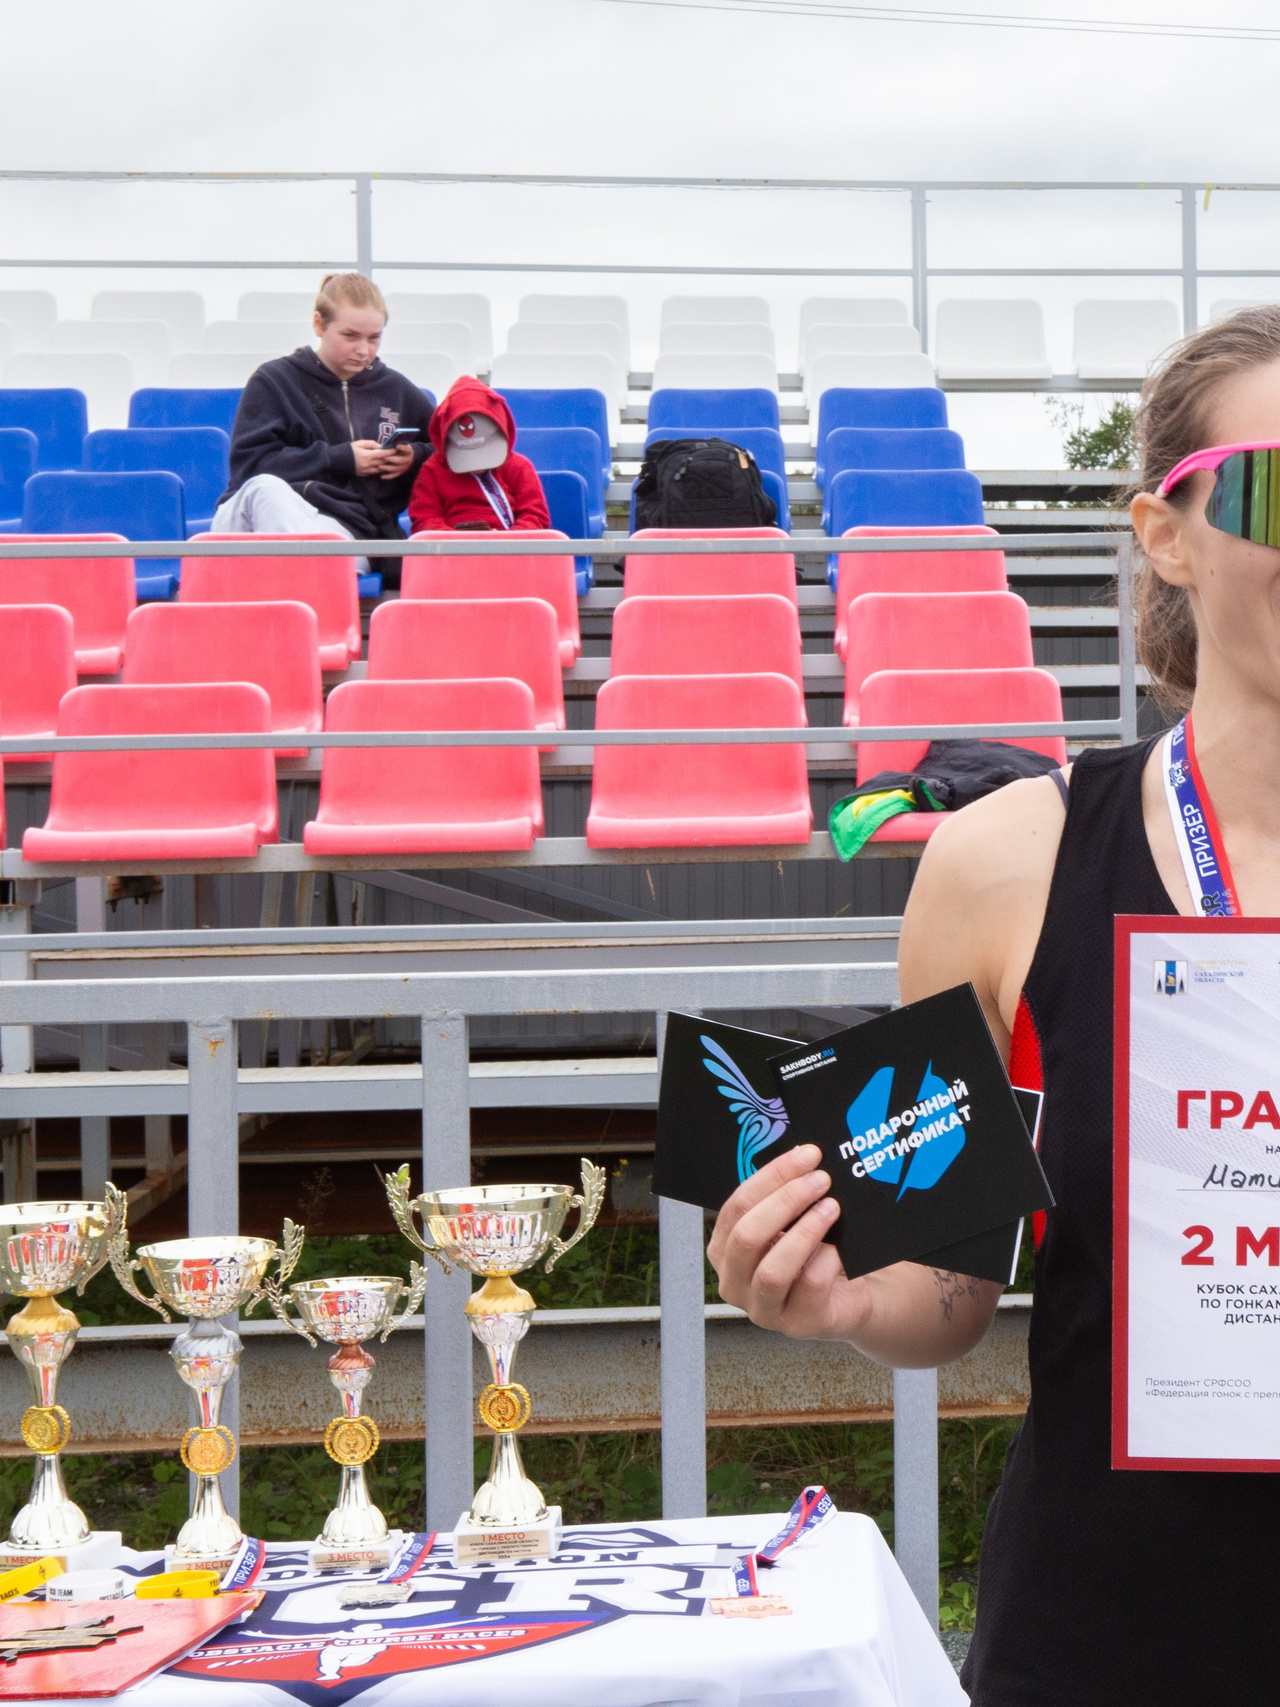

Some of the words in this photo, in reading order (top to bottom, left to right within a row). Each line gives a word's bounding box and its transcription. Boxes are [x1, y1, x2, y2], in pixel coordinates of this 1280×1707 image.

[1182, 804, 1218, 878] ПРИЗЁР
[838, 1078, 969, 1160] ПОДАРОЧНЫЙ
[851, 1104, 971, 1178] СЕРТИФИКАТ
[1181, 1225, 1214, 1266] 2
[1197, 1284, 1245, 1295] КУБОК
[1200, 1298, 1221, 1308] ПО
[1145, 1378, 1200, 1388] Президент
[1203, 1379, 1252, 1388] СРФСОО
[1145, 1389, 1209, 1400] «Федерация
[1212, 1391, 1241, 1399] гонок
[481, 1534, 486, 1542] 1
[488, 1532, 526, 1542] МЕСТО
[328, 1553, 335, 1562] 3
[337, 1551, 375, 1561] МЕСТО
[186, 1563, 192, 1571] 2
[195, 1560, 233, 1571] МЕСТО
[57, 1588, 73, 1597] TEAM
[188, 1639, 328, 1659] OBSTACLE
[333, 1634, 434, 1648] COURSE
[441, 1629, 527, 1641] RACES
